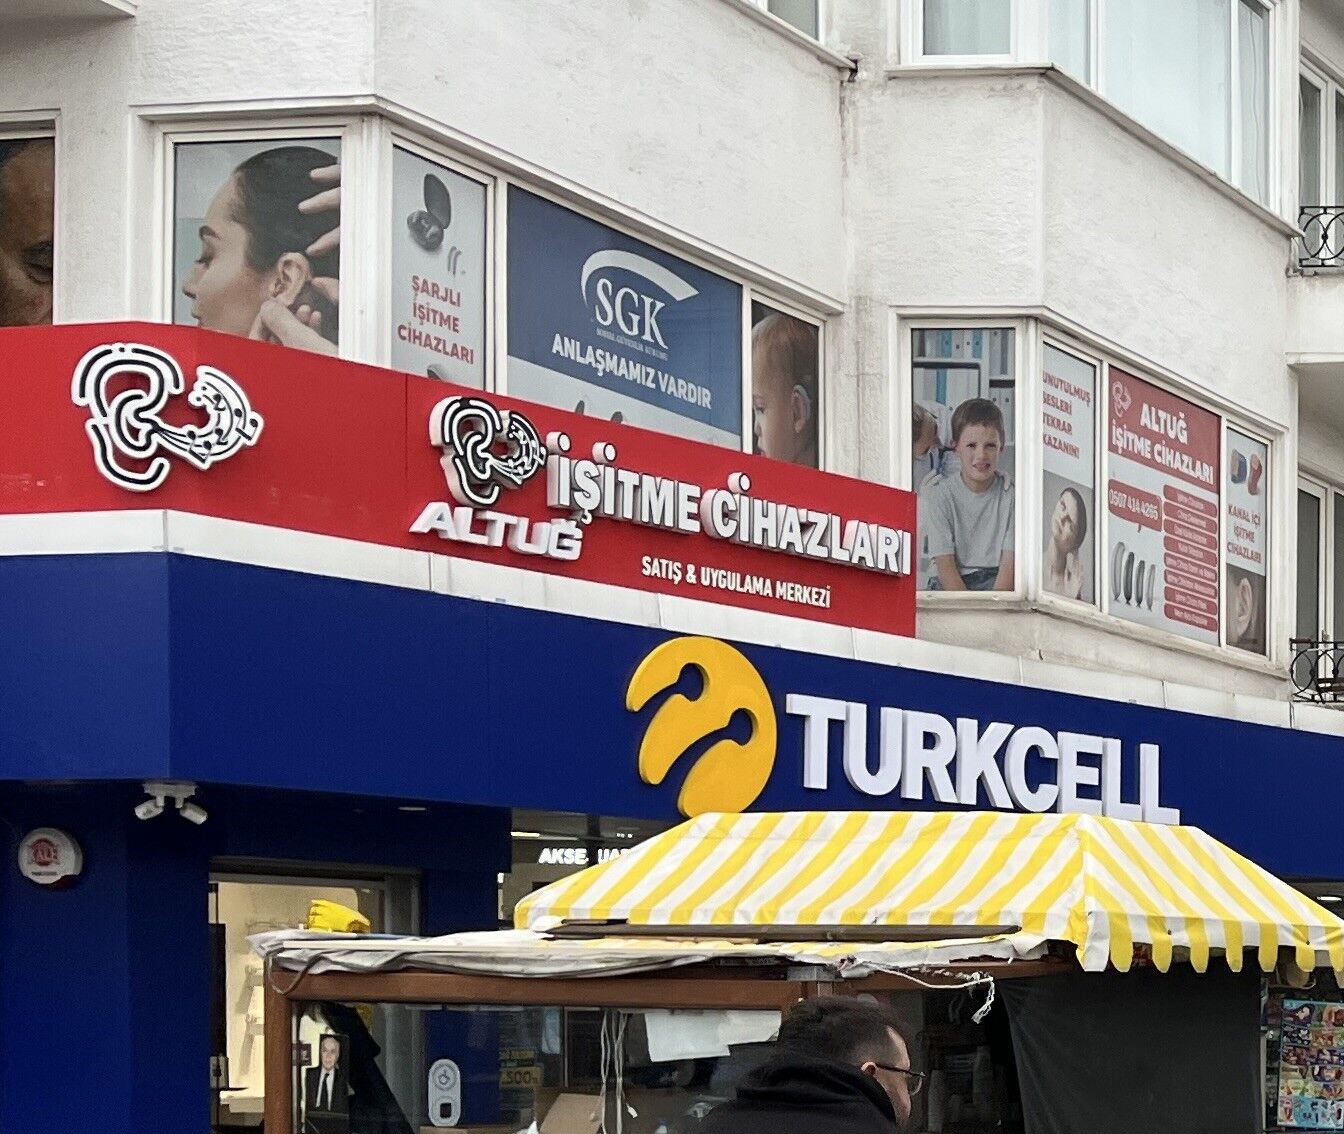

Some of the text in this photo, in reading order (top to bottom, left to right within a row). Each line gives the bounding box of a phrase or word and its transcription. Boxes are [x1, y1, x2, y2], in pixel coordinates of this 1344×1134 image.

[411, 275, 461, 307] ŞARJLI
[413, 301, 460, 334] İŞİTME
[595, 277, 669, 350] SGK
[397, 323, 474, 365] CİHAZLARI
[552, 333, 712, 409] ANLAŞMAMIZ VARDIR
[1112, 421, 1214, 486] İŞİTME CİHAZLARI
[1140, 403, 1188, 444] ALTUĞ
[408, 501, 584, 561] ALTUĞ
[547, 431, 912, 577] İŞİTME CİHAZLARI
[641, 556, 832, 608] SATIŞ & UYGULAMA MERKEZİ
[785, 692, 1181, 826] TURKCELL
